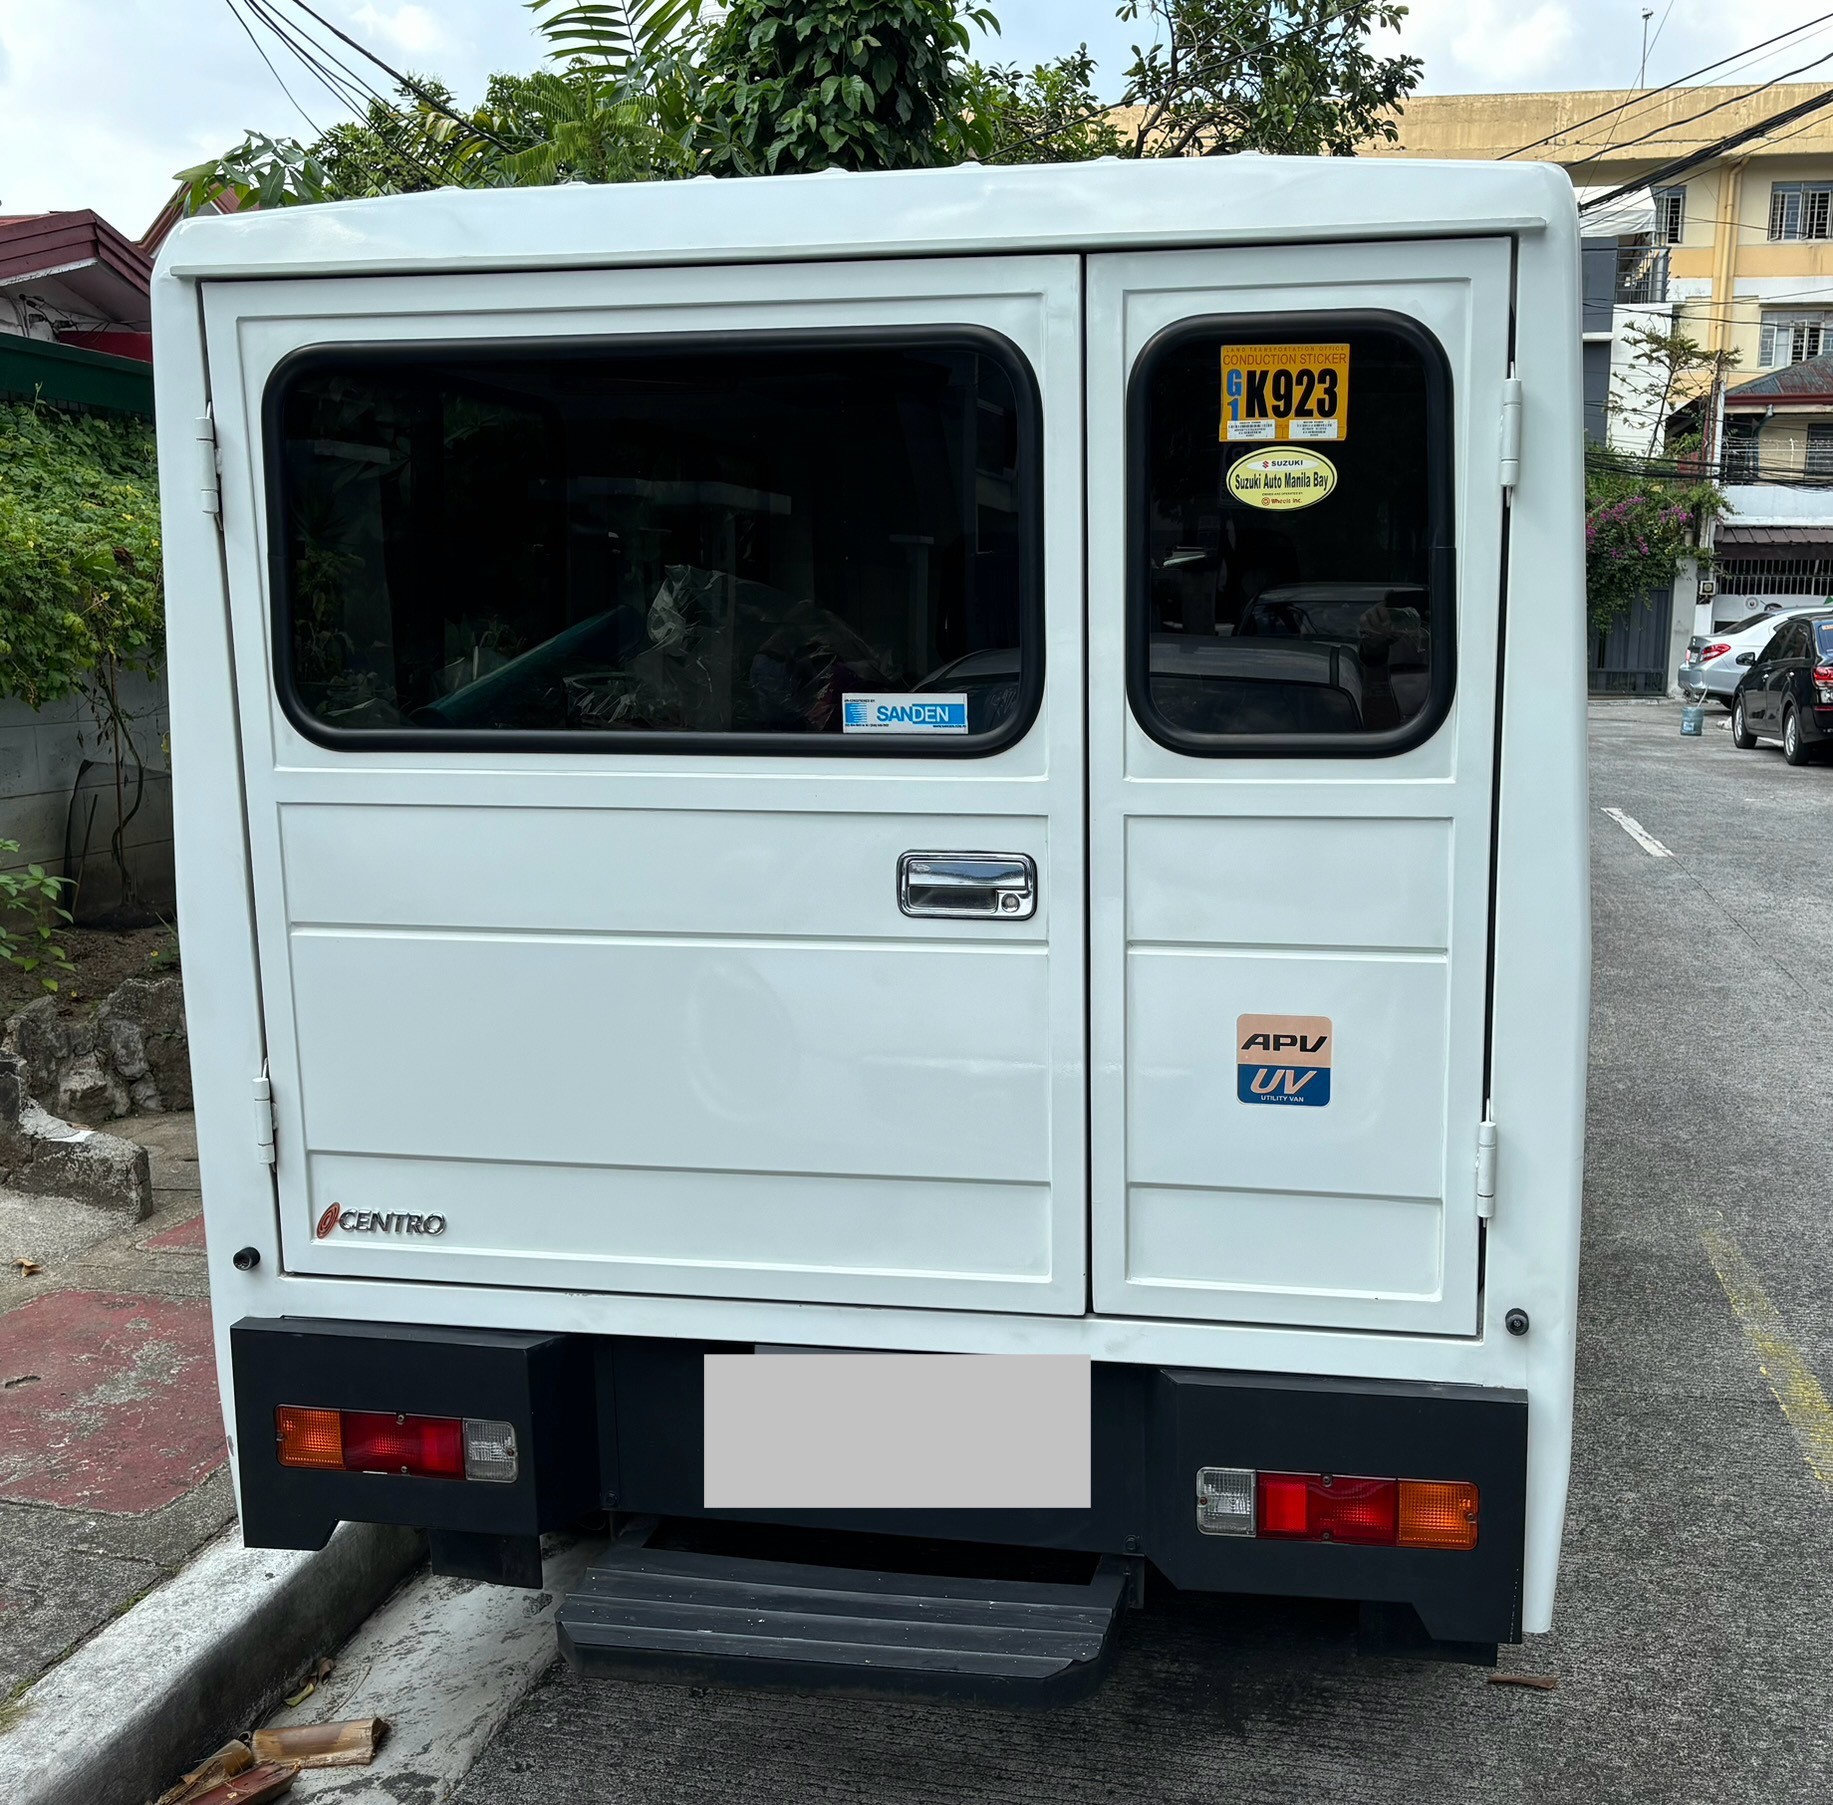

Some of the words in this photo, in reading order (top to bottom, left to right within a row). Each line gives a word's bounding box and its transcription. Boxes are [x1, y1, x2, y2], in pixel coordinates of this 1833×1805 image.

[1223, 353, 1297, 366] CONDUCTION
[1299, 353, 1347, 365] STICKER
[1245, 368, 1338, 418] K923
[1271, 459, 1304, 467] SUZUKI
[1235, 473, 1262, 490] Suzuki
[1263, 473, 1282, 489] Auto
[1284, 472, 1311, 488] Manila
[1313, 471, 1329, 491] Bay
[876, 705, 949, 722] SANDEN
[1241, 1033, 1328, 1053] APV
[1250, 1068, 1318, 1095] UV
[1288, 1095, 1304, 1103] VAN
[338, 1208, 447, 1236] CENTRO
